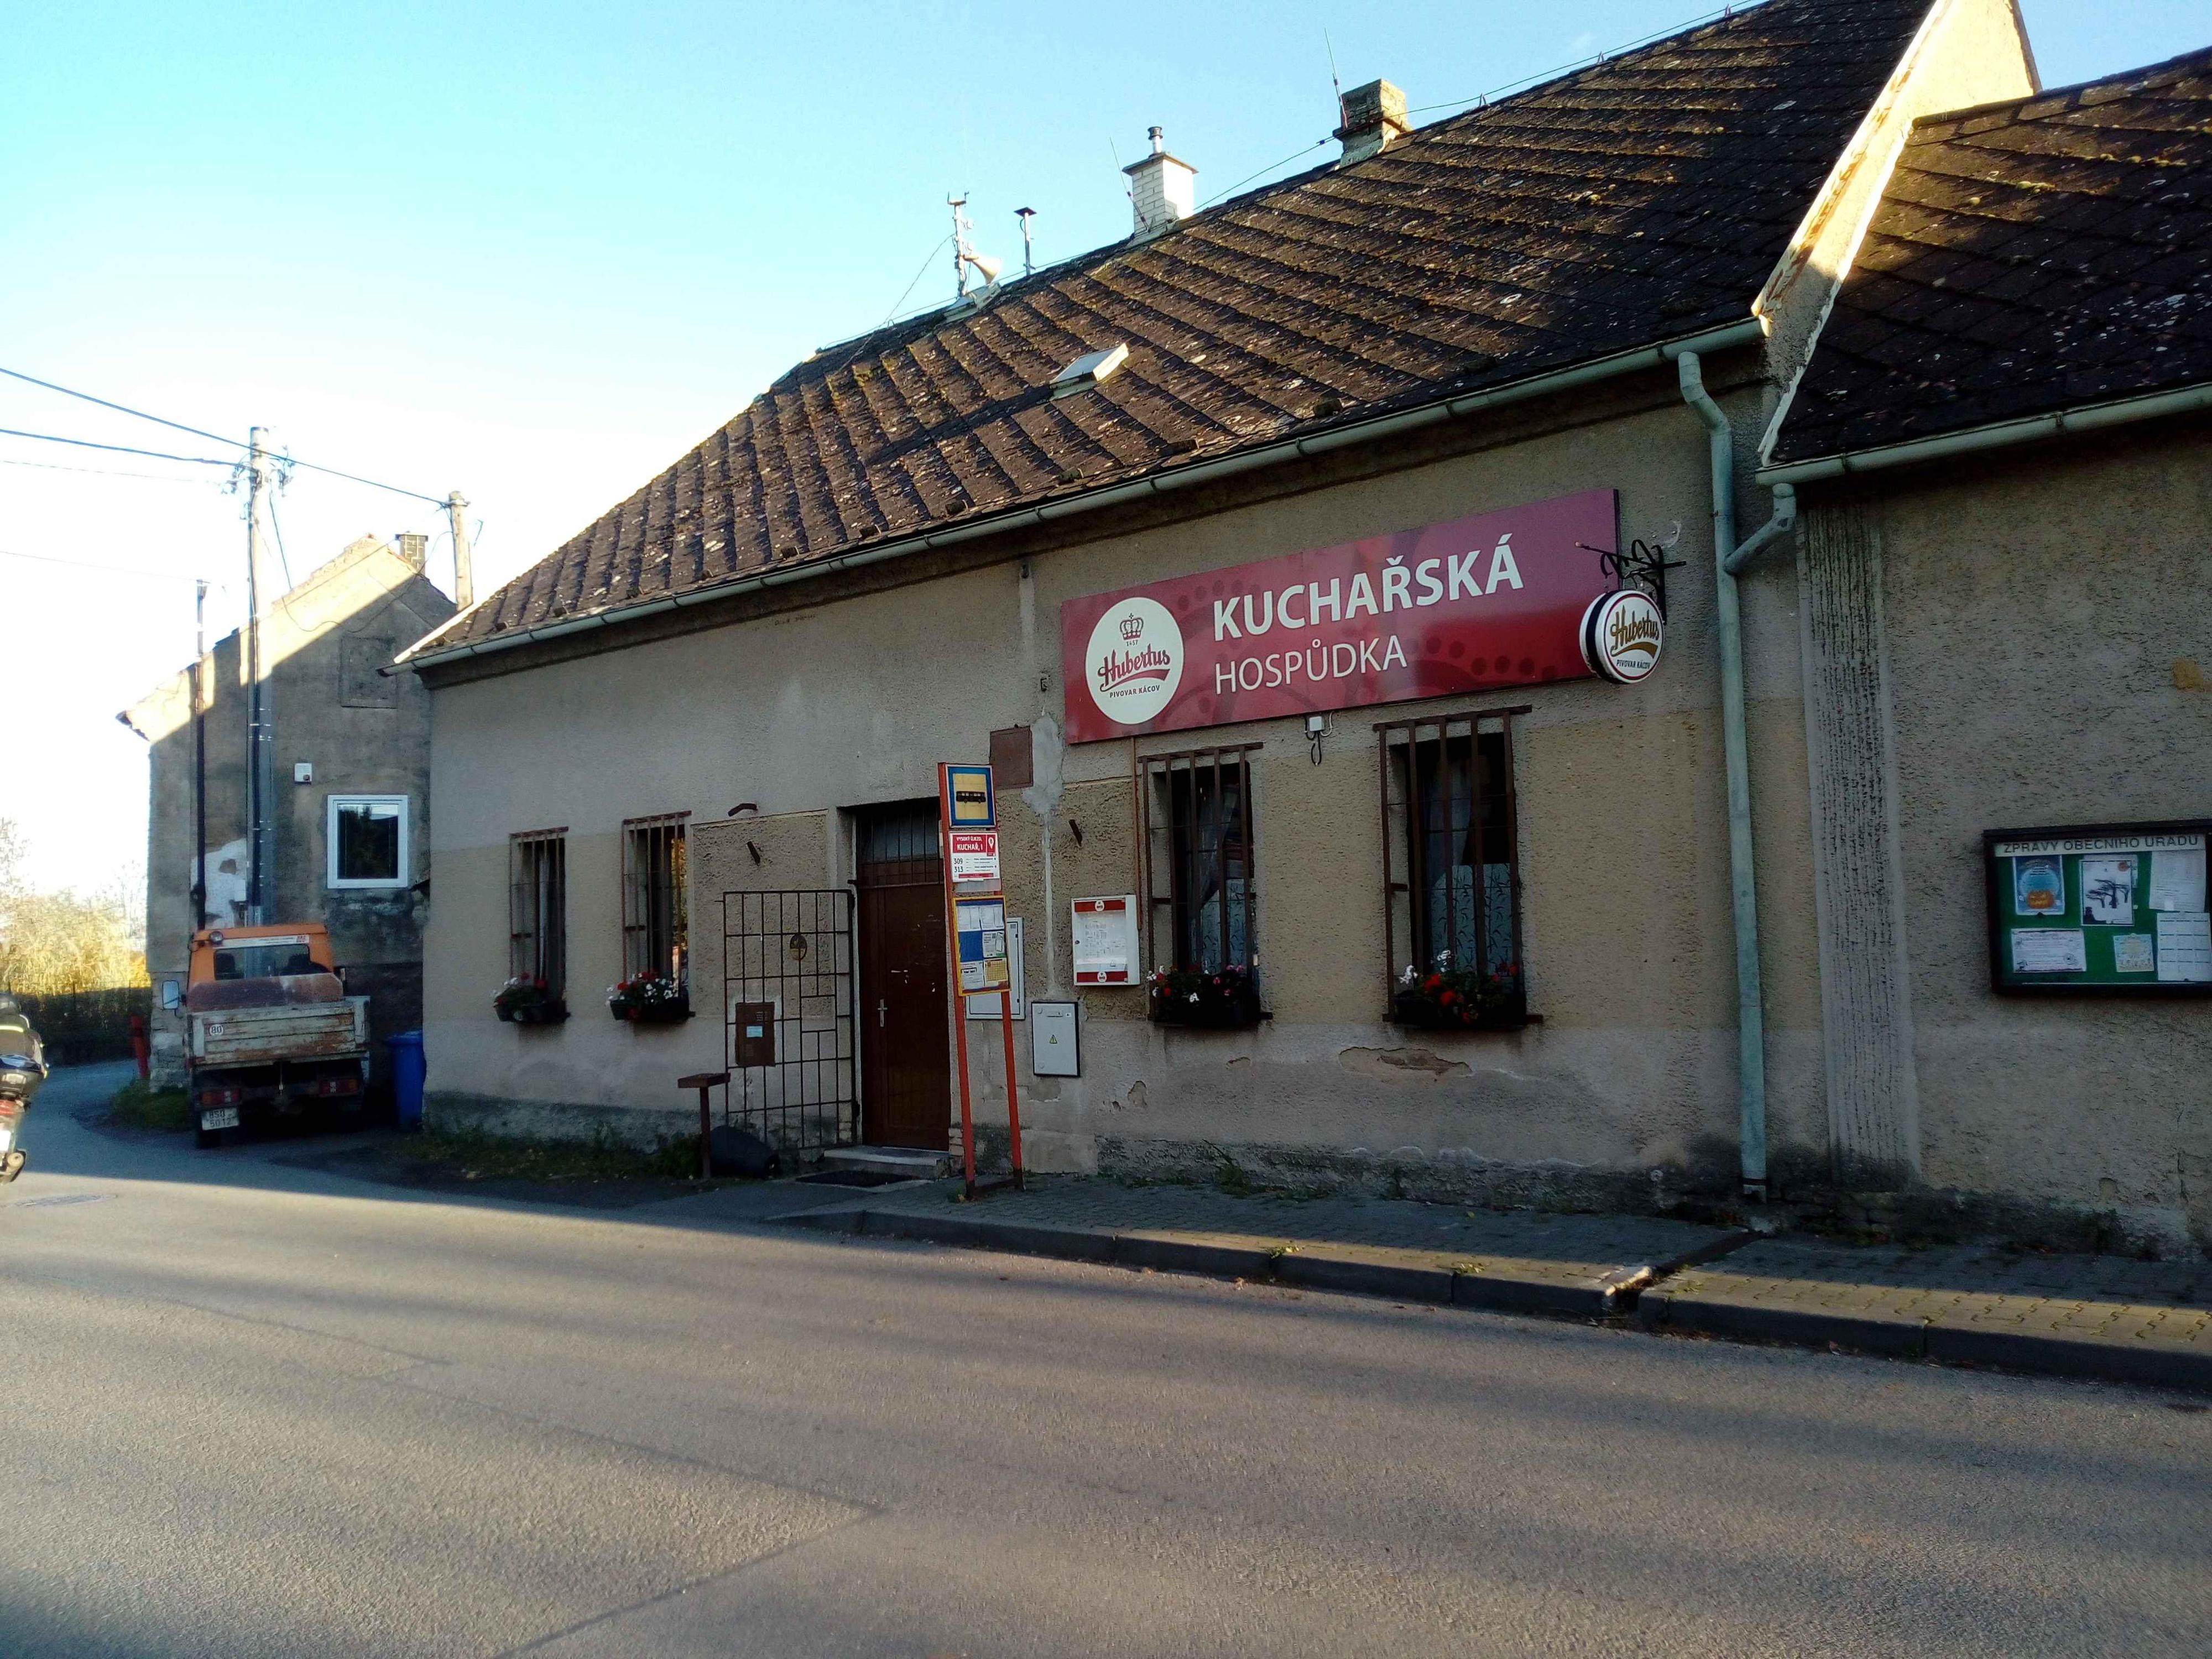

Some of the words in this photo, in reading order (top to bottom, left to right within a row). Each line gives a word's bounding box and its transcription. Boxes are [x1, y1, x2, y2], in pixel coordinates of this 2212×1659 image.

[1213, 533, 1524, 641] KUCHAŘSKÁ
[1610, 604, 1659, 650] Hubertus
[1097, 643, 1171, 687] Hubertus
[1215, 635, 1407, 695] HOSPŮDKA
[1616, 659, 1636, 668] PIVOVAR
[1109, 688, 1138, 698] PIVOVAR
[1138, 685, 1161, 694] KÁCOV
